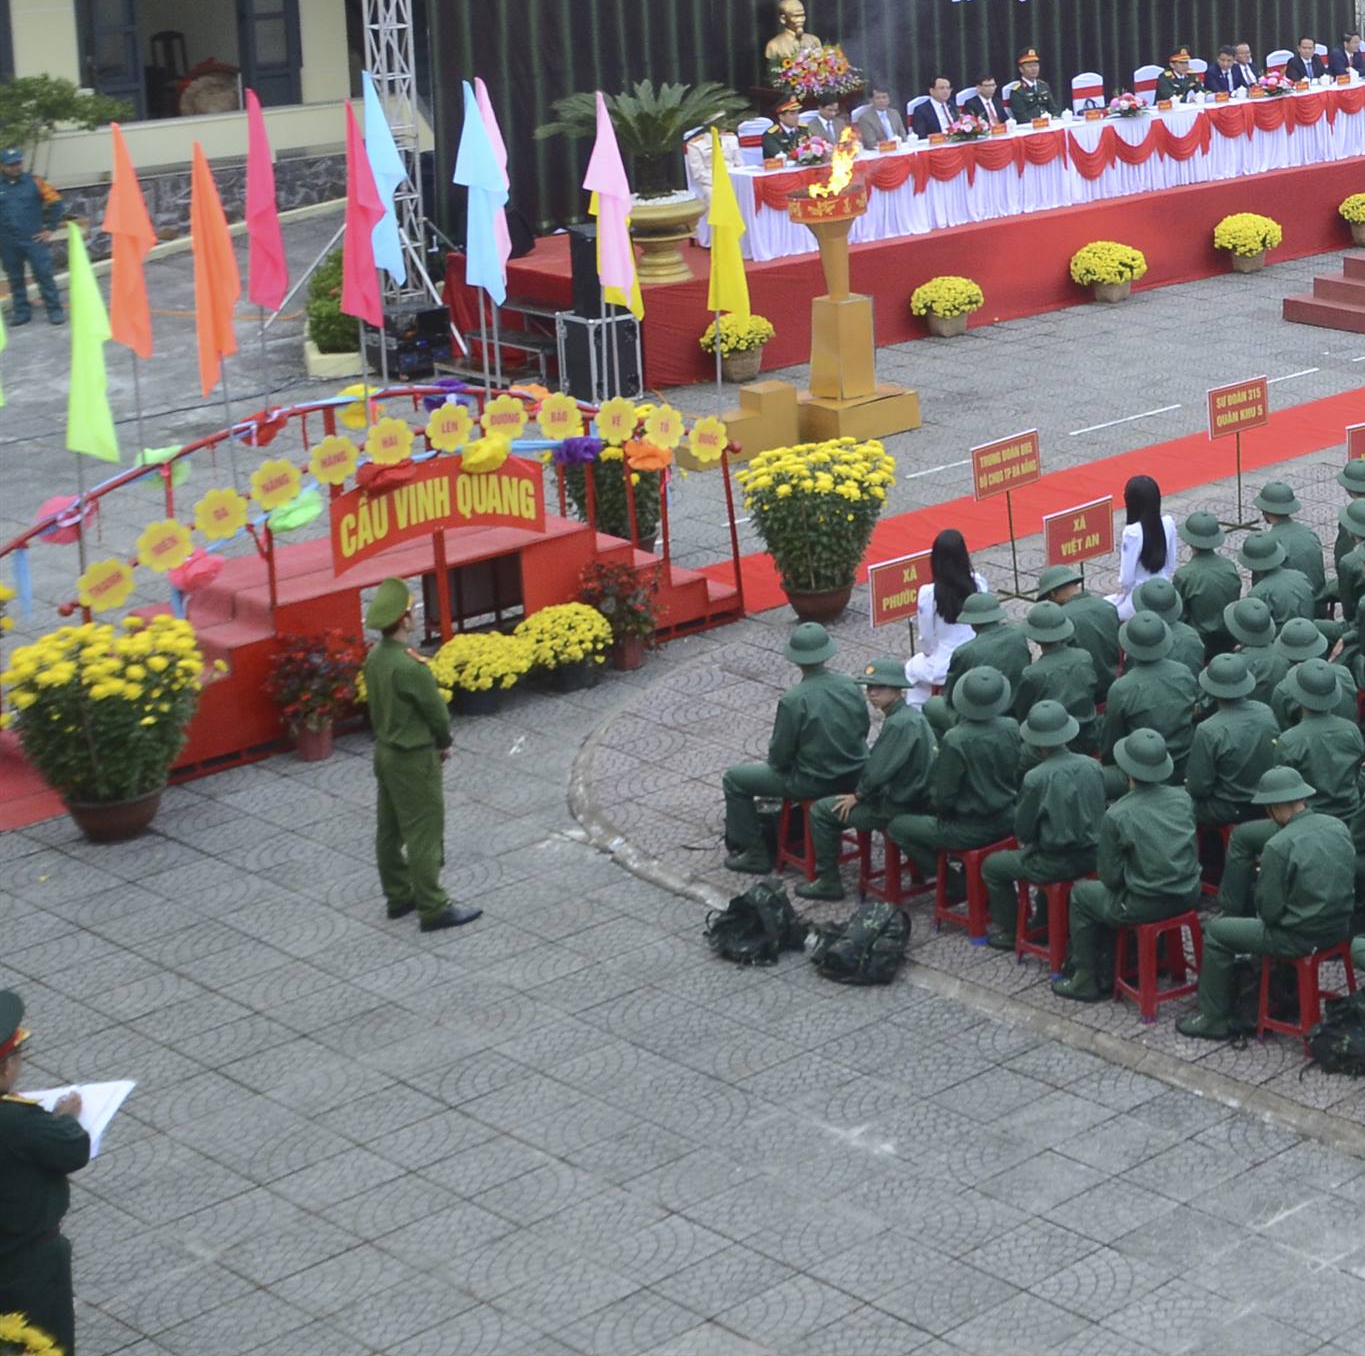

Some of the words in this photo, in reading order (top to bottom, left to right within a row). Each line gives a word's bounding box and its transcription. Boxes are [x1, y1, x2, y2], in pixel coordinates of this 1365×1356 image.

[339, 489, 390, 558] CẦU
[393, 476, 450, 530] VINH
[456, 473, 536, 520] QUANG
[1085, 532, 1100, 549] AN
